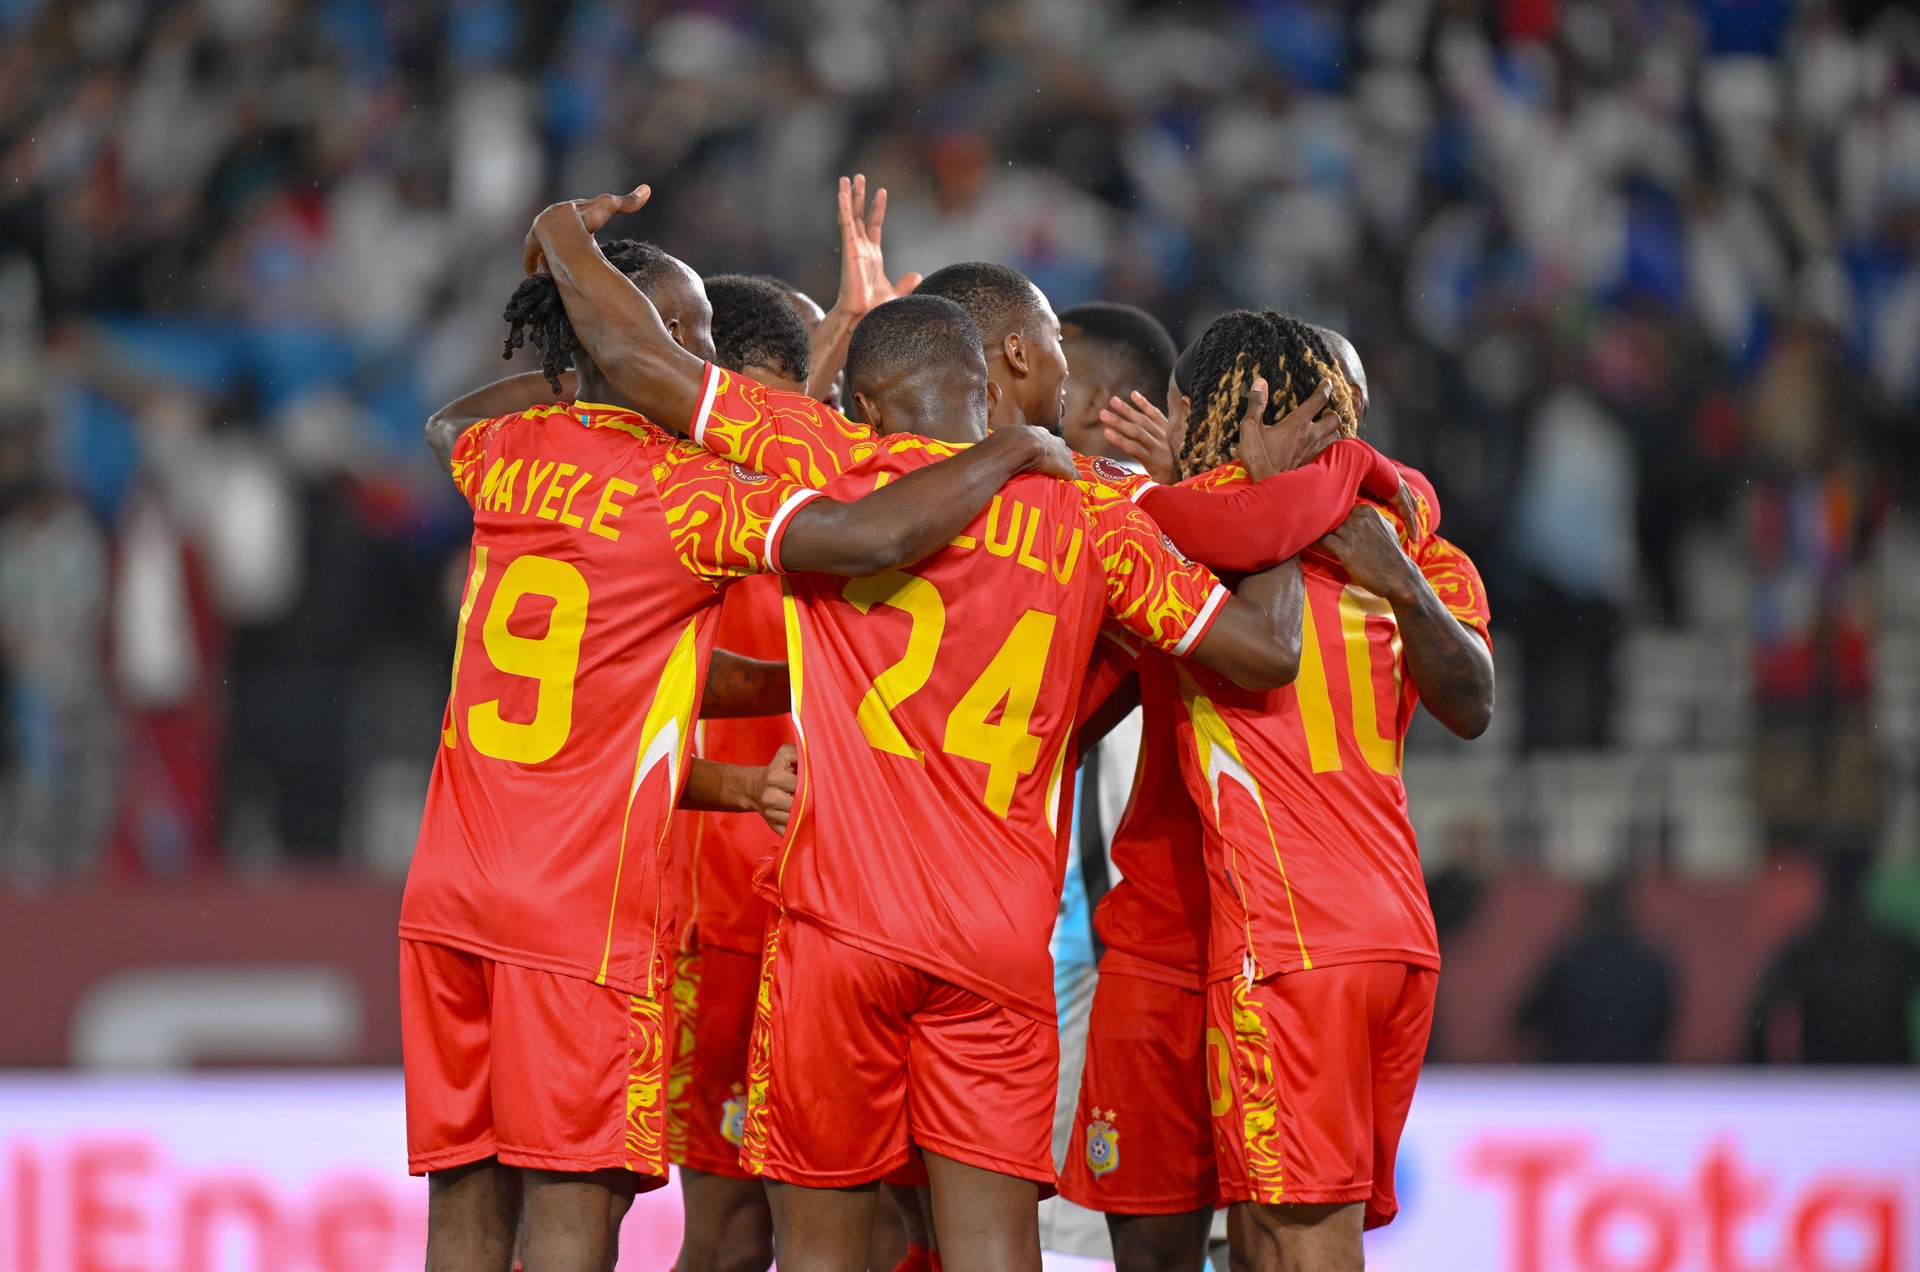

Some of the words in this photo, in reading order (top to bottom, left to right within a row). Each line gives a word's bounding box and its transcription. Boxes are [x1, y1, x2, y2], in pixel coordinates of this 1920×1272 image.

[475, 457, 639, 543] MAYELE
[842, 568, 1057, 820] 24
[1294, 583, 1404, 776] 10
